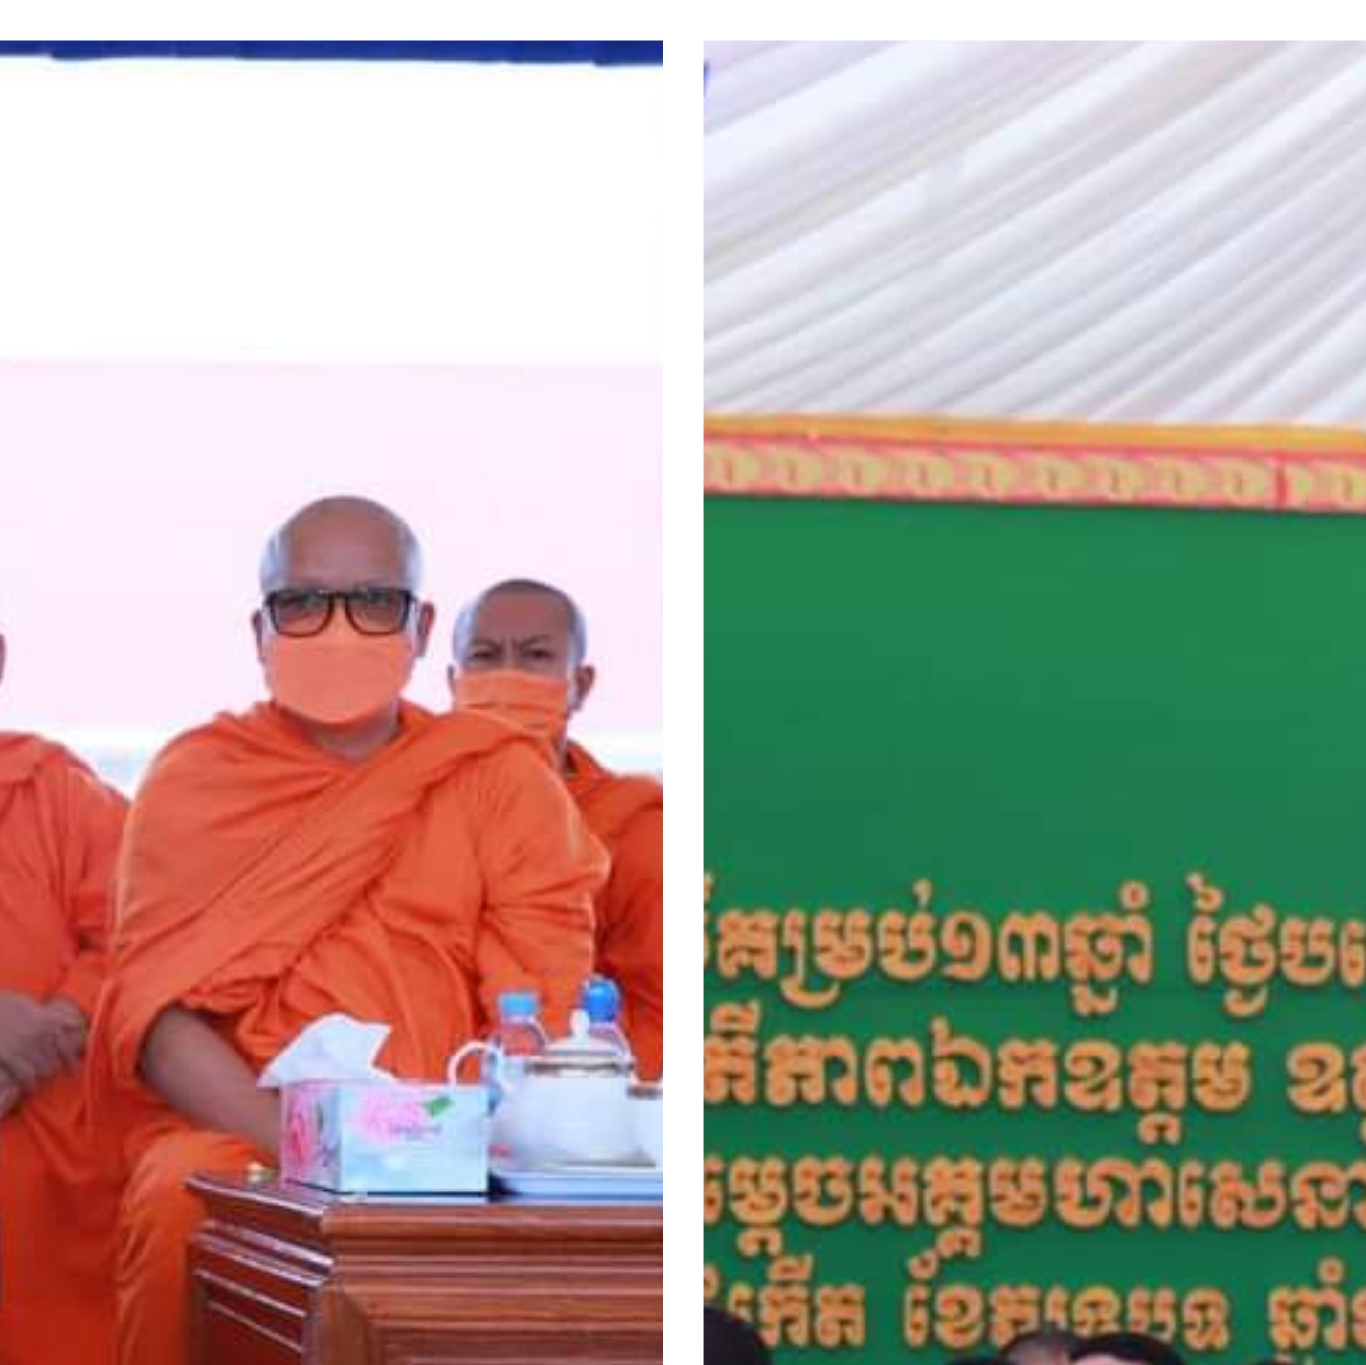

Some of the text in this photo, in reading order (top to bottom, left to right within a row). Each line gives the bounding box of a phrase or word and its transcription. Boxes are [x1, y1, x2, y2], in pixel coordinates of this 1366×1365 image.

[703, 875, 1153, 1016] គម្រប់១៣ឆ្នាំ
